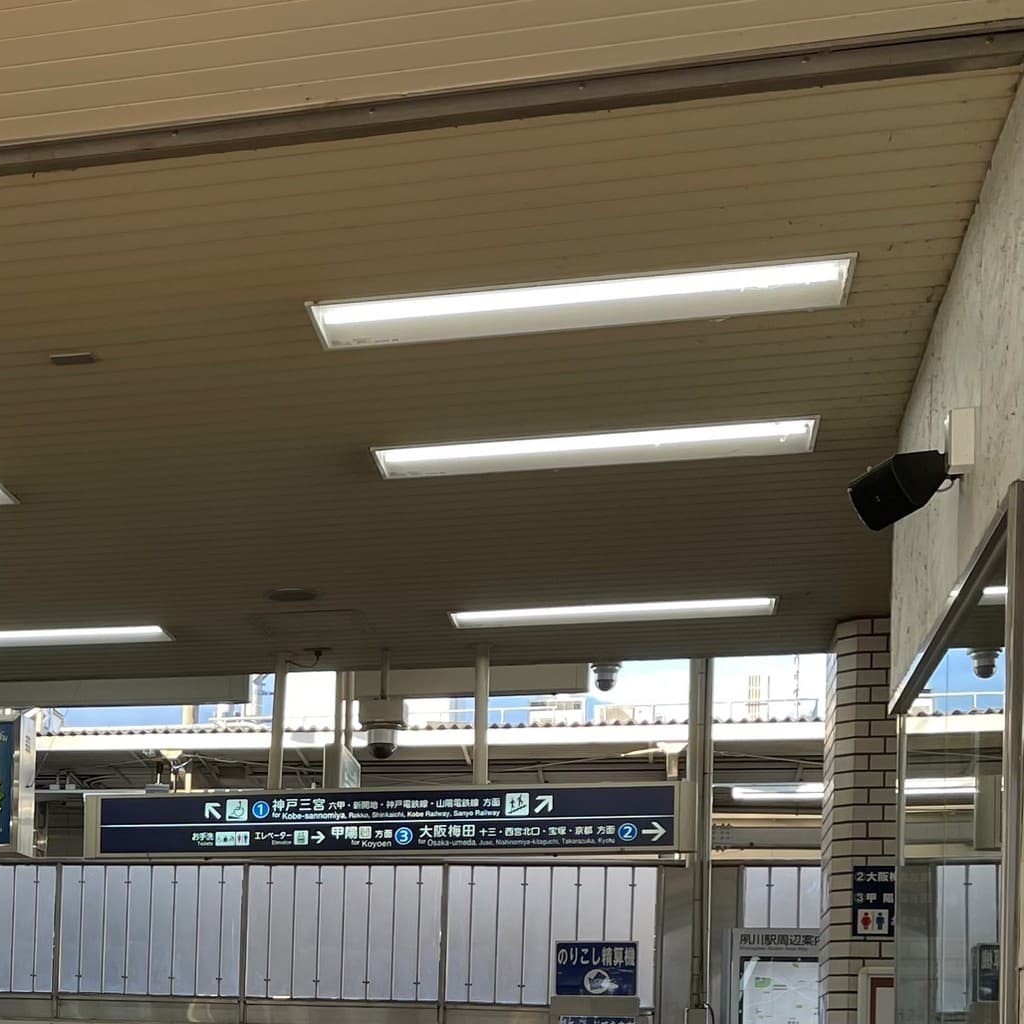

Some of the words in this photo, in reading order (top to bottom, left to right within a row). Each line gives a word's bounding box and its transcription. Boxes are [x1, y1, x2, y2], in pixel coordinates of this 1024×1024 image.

[272, 798, 326, 811] 神戸三宮
[482, 797, 501, 807] 方面
[254, 831, 293, 840] エレベーター
[374, 829, 393, 839] 方面
[419, 824, 476, 838] 大阪梅田
[596, 825, 616, 835] 方面
[361, 840, 392, 848] Koyoen
[557, 947, 636, 967] のりこし精算機
